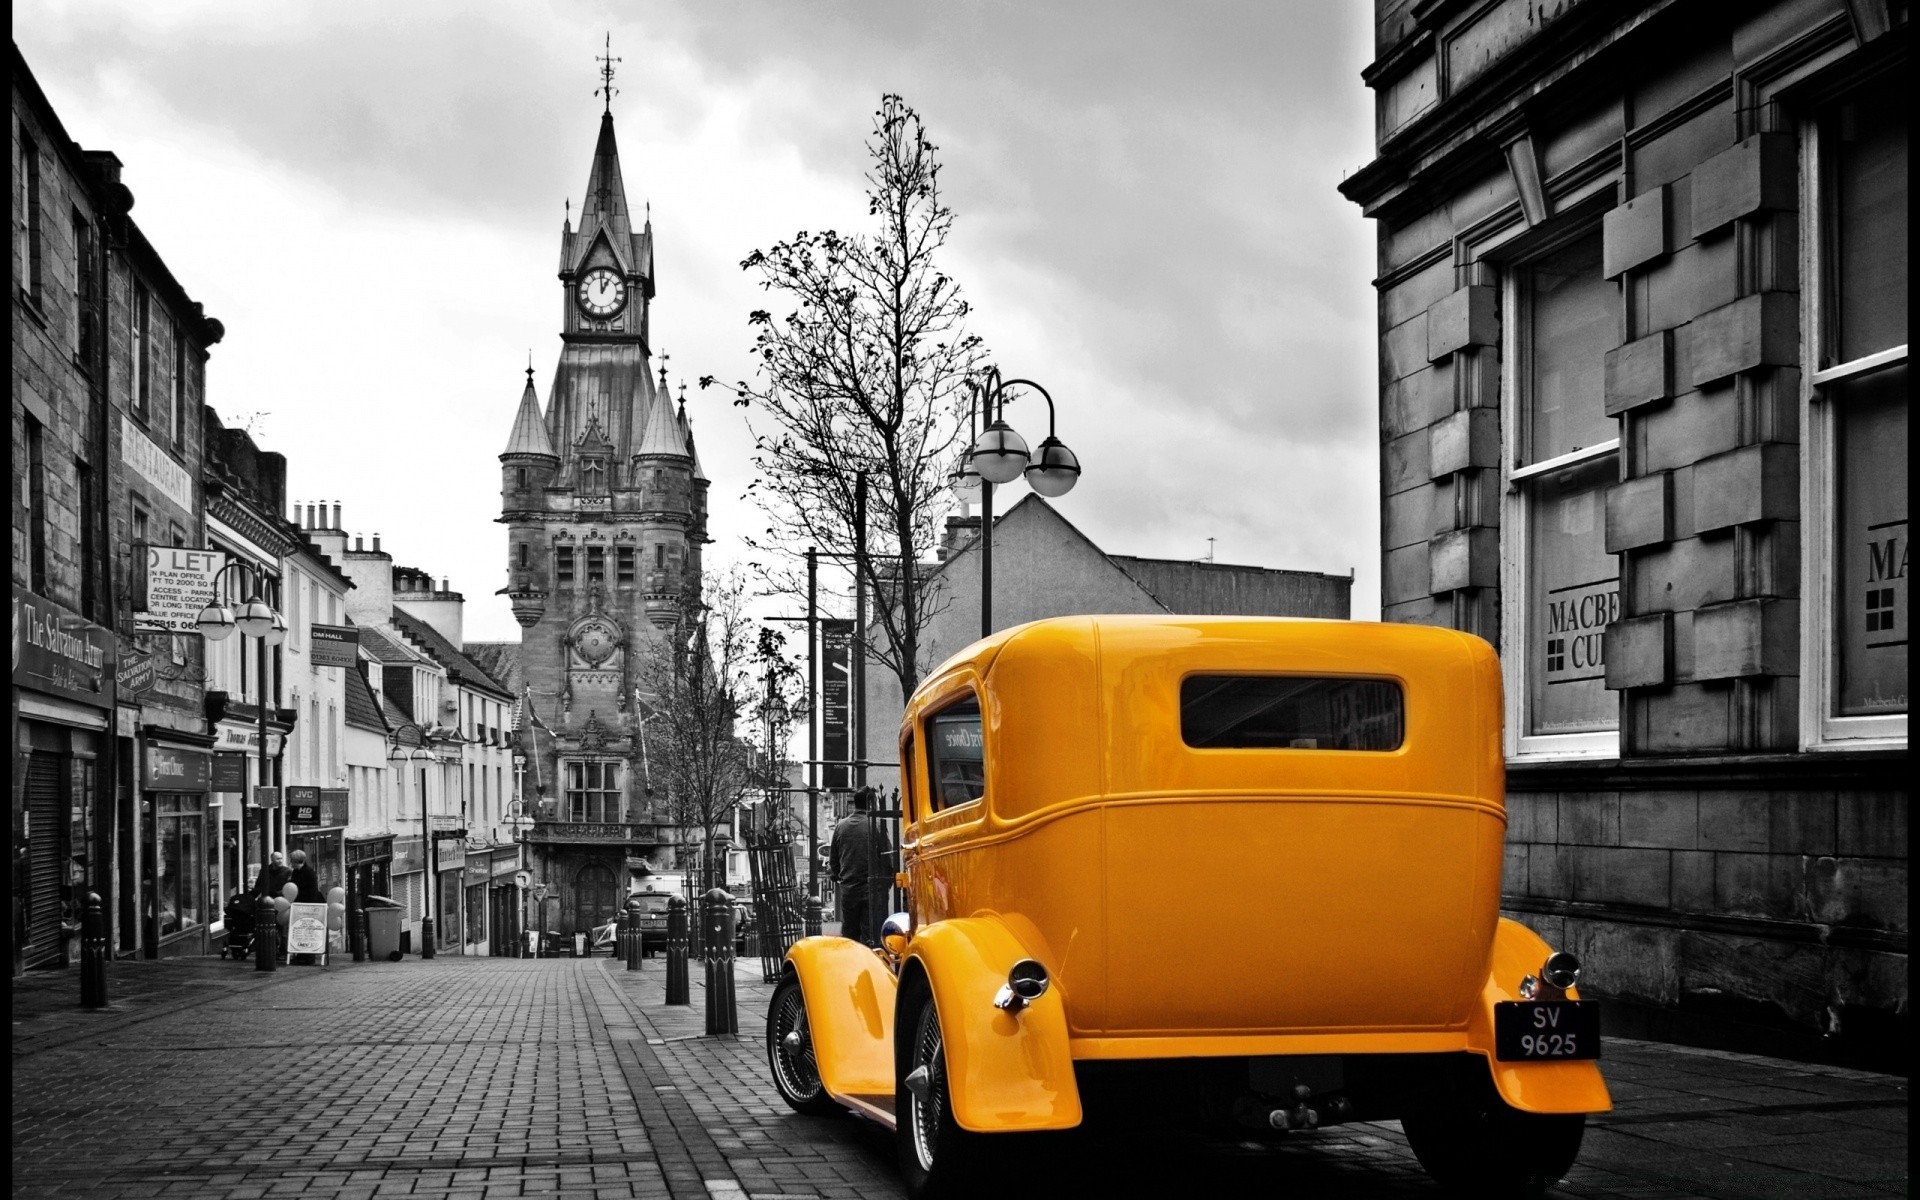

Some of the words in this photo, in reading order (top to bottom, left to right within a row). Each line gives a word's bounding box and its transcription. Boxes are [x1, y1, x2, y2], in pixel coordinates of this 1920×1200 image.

[128, 424, 187, 503] RESTAURANT
[172, 551, 216, 573] LET
[159, 570, 178, 578] PLAN
[180, 572, 205, 580] OFFICE
[176, 579, 195, 587] 2000
[151, 593, 178, 602] CENTRE
[153, 586, 182, 595] ACCESS
[24, 603, 44, 648] The
[46, 613, 83, 662] Salvation
[1571, 632, 1606, 669] CU
[117, 657, 152, 682] SALVATION
[123, 655, 138, 668] THE
[129, 669, 151, 689] ARMY
[227, 728, 246, 744] Thomas
[295, 790, 313, 799] JVC
[1533, 1007, 1560, 1028] SV
[1521, 1034, 1576, 1055] 9625
